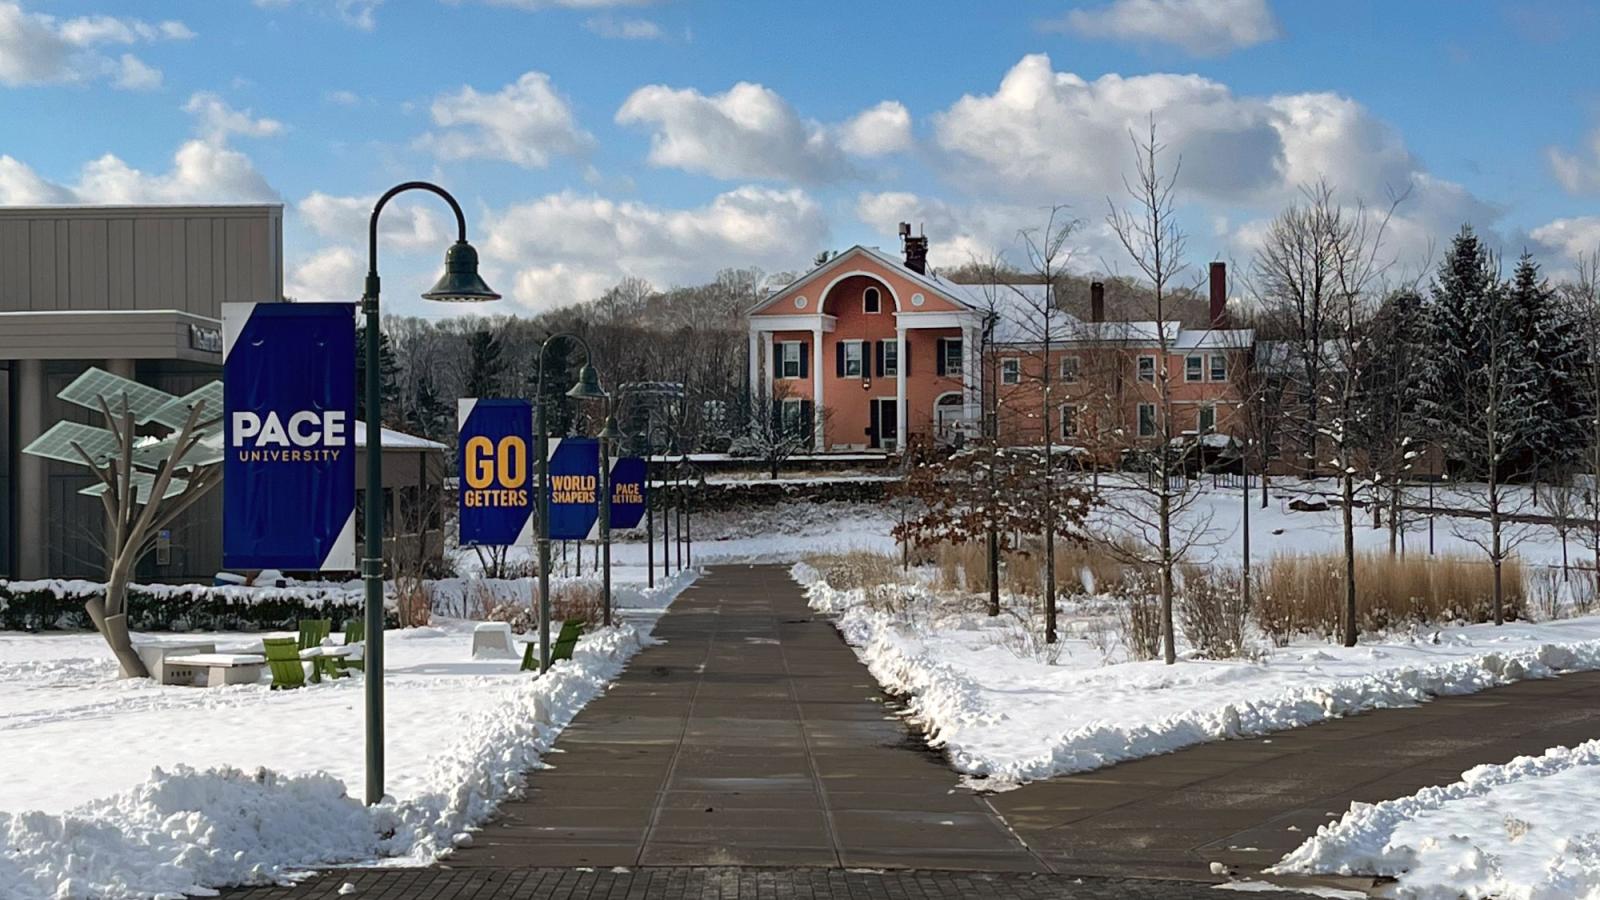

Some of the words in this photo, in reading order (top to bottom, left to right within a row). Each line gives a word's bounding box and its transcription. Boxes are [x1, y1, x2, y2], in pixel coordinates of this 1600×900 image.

[232, 410, 346, 447] PACE
[239, 449, 340, 462] UNIVERSITY
[465, 435, 527, 489] GO
[551, 475, 596, 491] WORLD
[615, 482, 640, 495] PACE
[464, 489, 528, 507] GETTERS
[551, 491, 596, 504] SHAPERS
[612, 494, 643, 504] SETTERS
